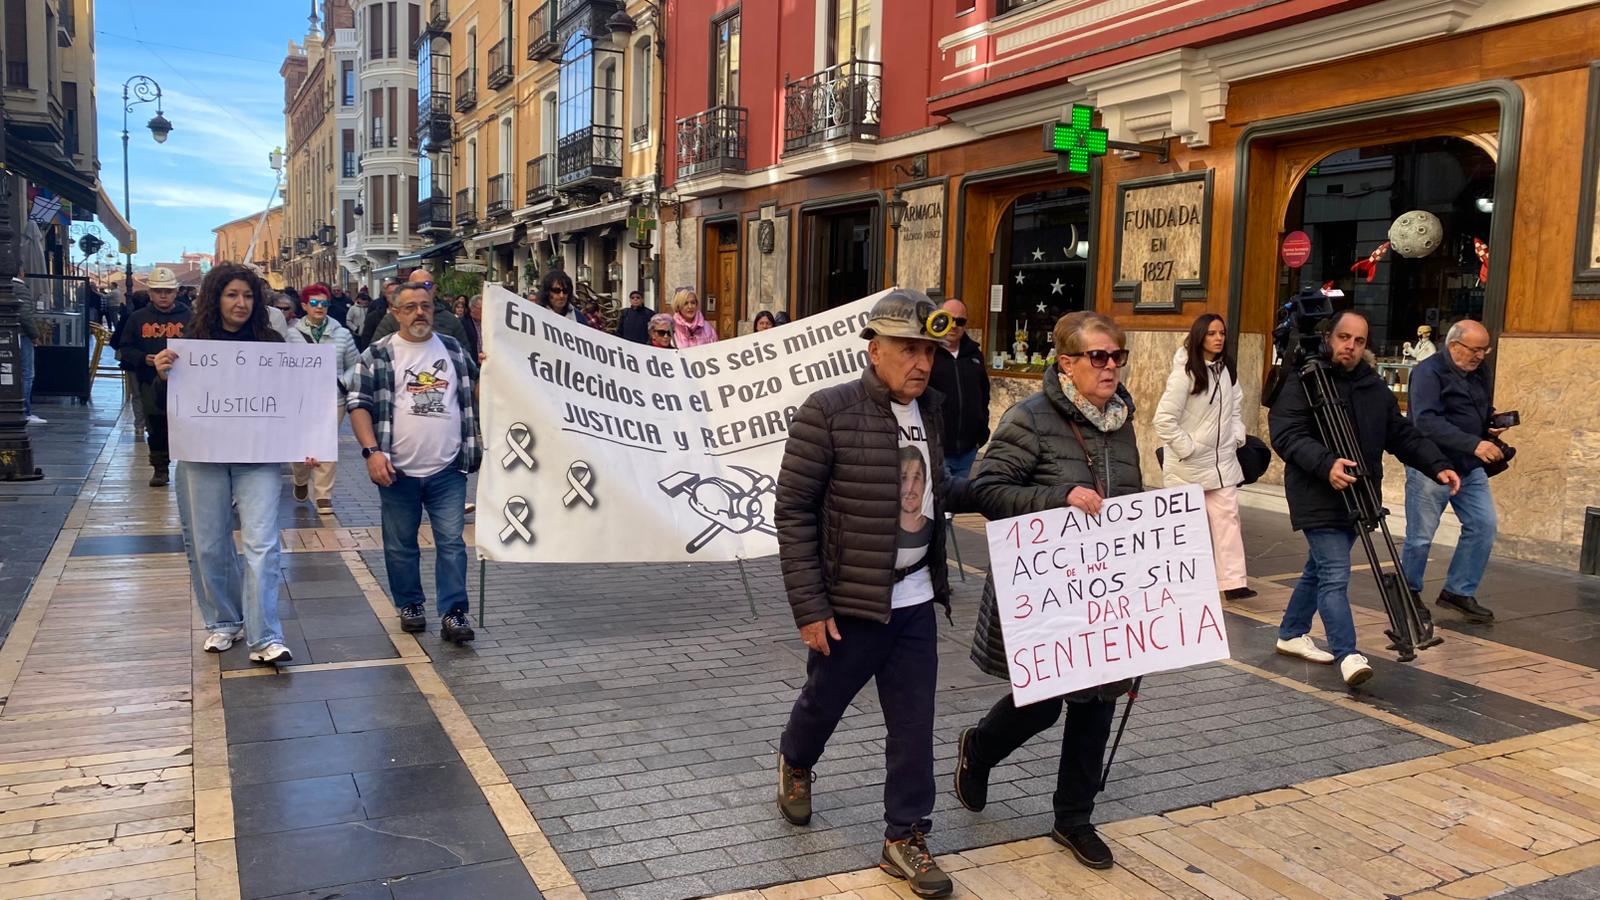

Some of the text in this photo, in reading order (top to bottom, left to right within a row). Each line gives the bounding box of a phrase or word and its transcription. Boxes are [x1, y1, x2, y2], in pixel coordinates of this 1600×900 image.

[903, 202, 942, 222] ARMACIA
[1124, 205, 1201, 231] FUNDADA
[1150, 237, 1167, 253] EN
[1142, 260, 1175, 282] 1827
[505, 301, 870, 379] En memoria de los seis minero
[188, 350, 322, 368] LOS 6 DE TABLIZA
[527, 347, 870, 413] fallecidos en el Pozo Emilio
[197, 391, 277, 414] JUSTICIA
[562, 401, 797, 451] JUSTICIA y REPARA
[897, 426, 928, 441] NOL
[1006, 518, 1048, 549] 12
[1154, 492, 1200, 518] DEL
[1066, 562, 1109, 578] DE HVL
[1014, 594, 1033, 619] 3
[1041, 572, 1126, 613] AÑOS
[1087, 587, 1176, 625] DAR LA
